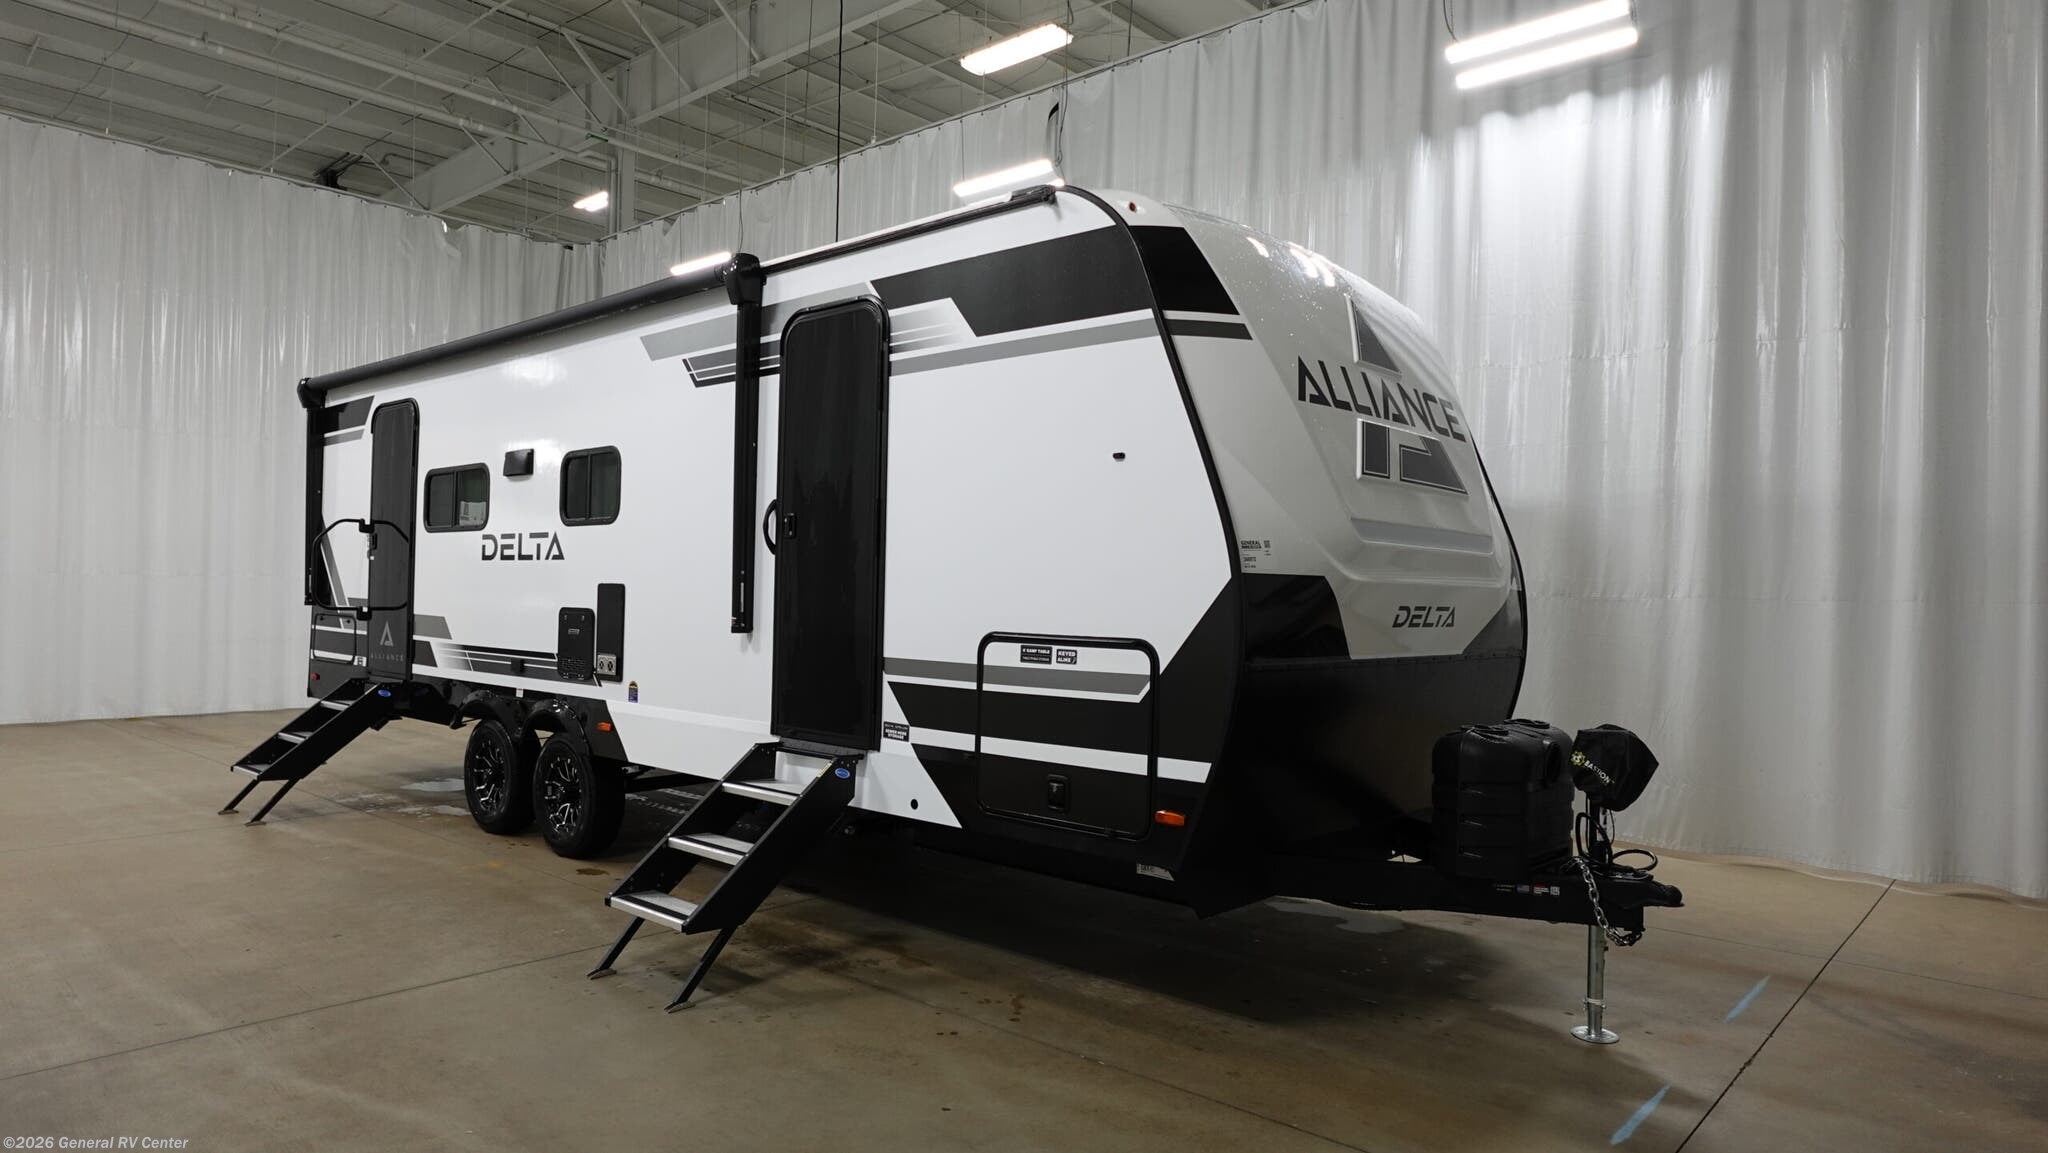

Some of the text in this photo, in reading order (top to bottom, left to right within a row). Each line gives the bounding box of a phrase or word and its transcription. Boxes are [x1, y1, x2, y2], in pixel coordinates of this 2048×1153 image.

[1297, 355, 1467, 443] ALLIANCE
[481, 531, 565, 561] DELTA
[1392, 605, 1455, 628] DELTA
[370, 652, 405, 661] ALLIANCE
[1584, 760, 1611, 783] BASTION
